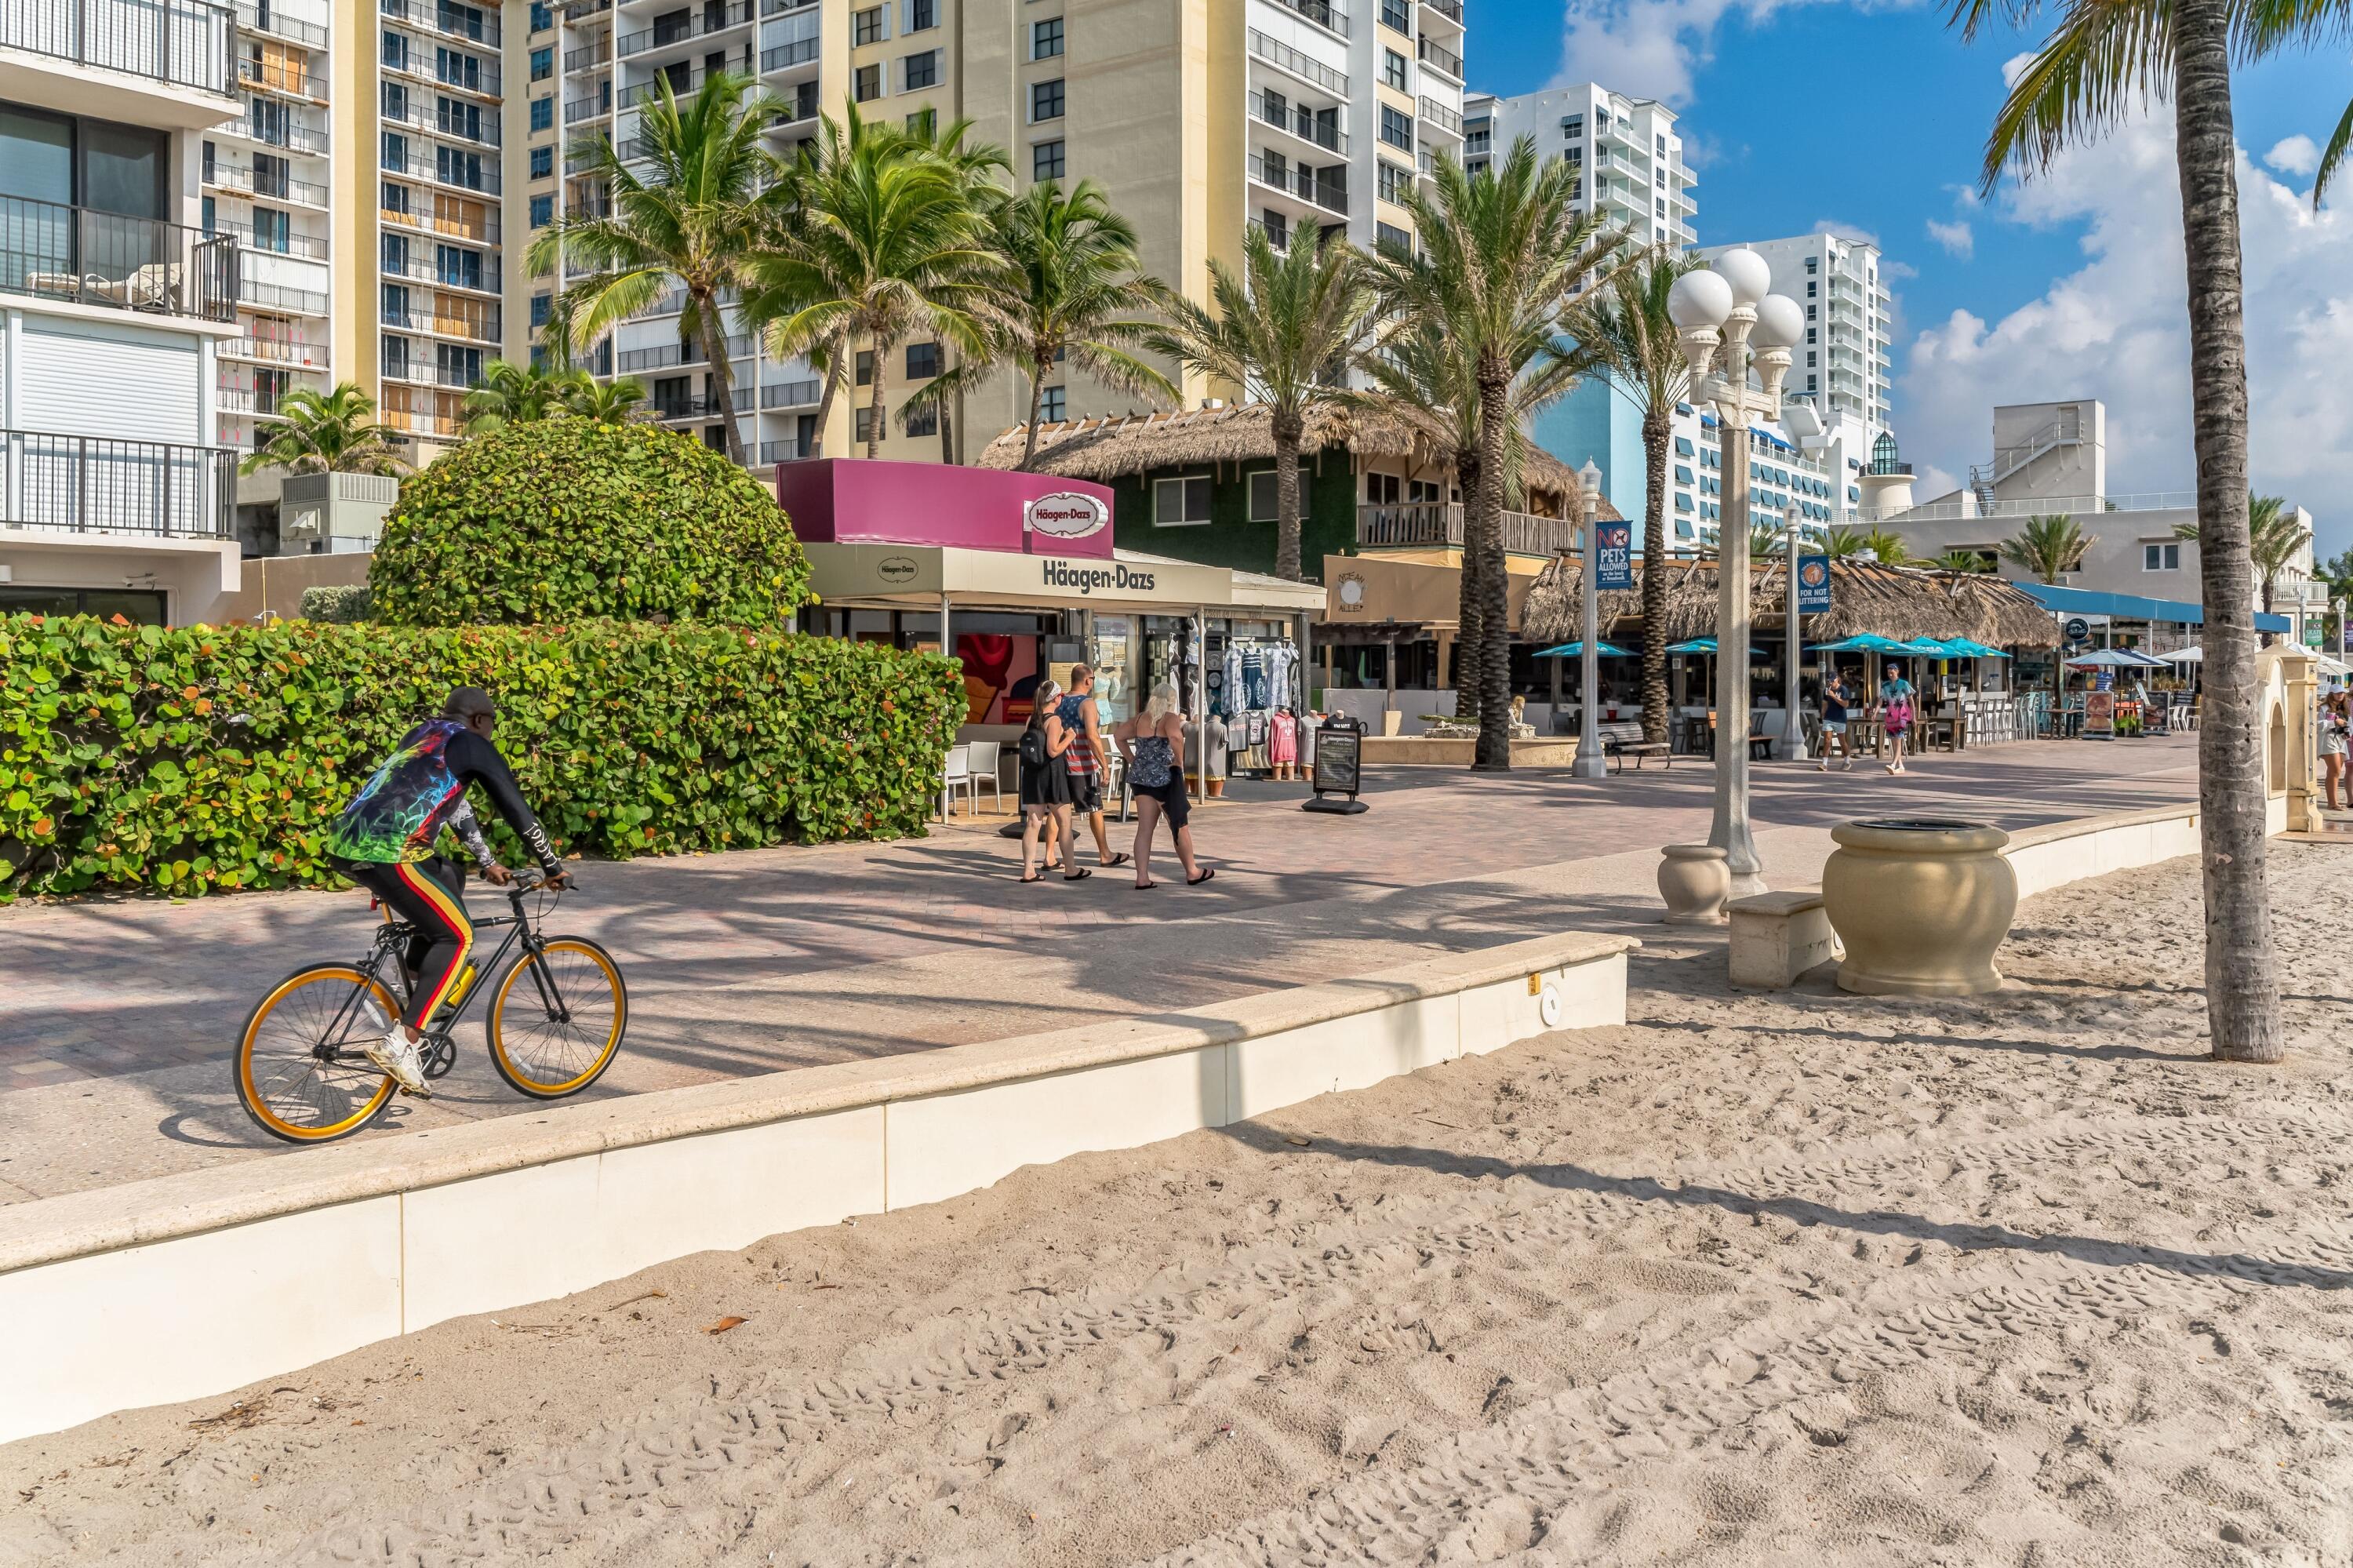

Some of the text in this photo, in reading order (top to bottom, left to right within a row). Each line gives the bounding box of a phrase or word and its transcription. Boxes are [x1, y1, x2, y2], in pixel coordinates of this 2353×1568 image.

[1036, 508, 1090, 522] Häagen-Dazs
[1600, 548, 1626, 562] PETS
[882, 566, 914, 575] Häagen-Dazs
[1598, 562, 1628, 571] ALLOWED
[1043, 560, 1155, 595] Häagen-Dazs
